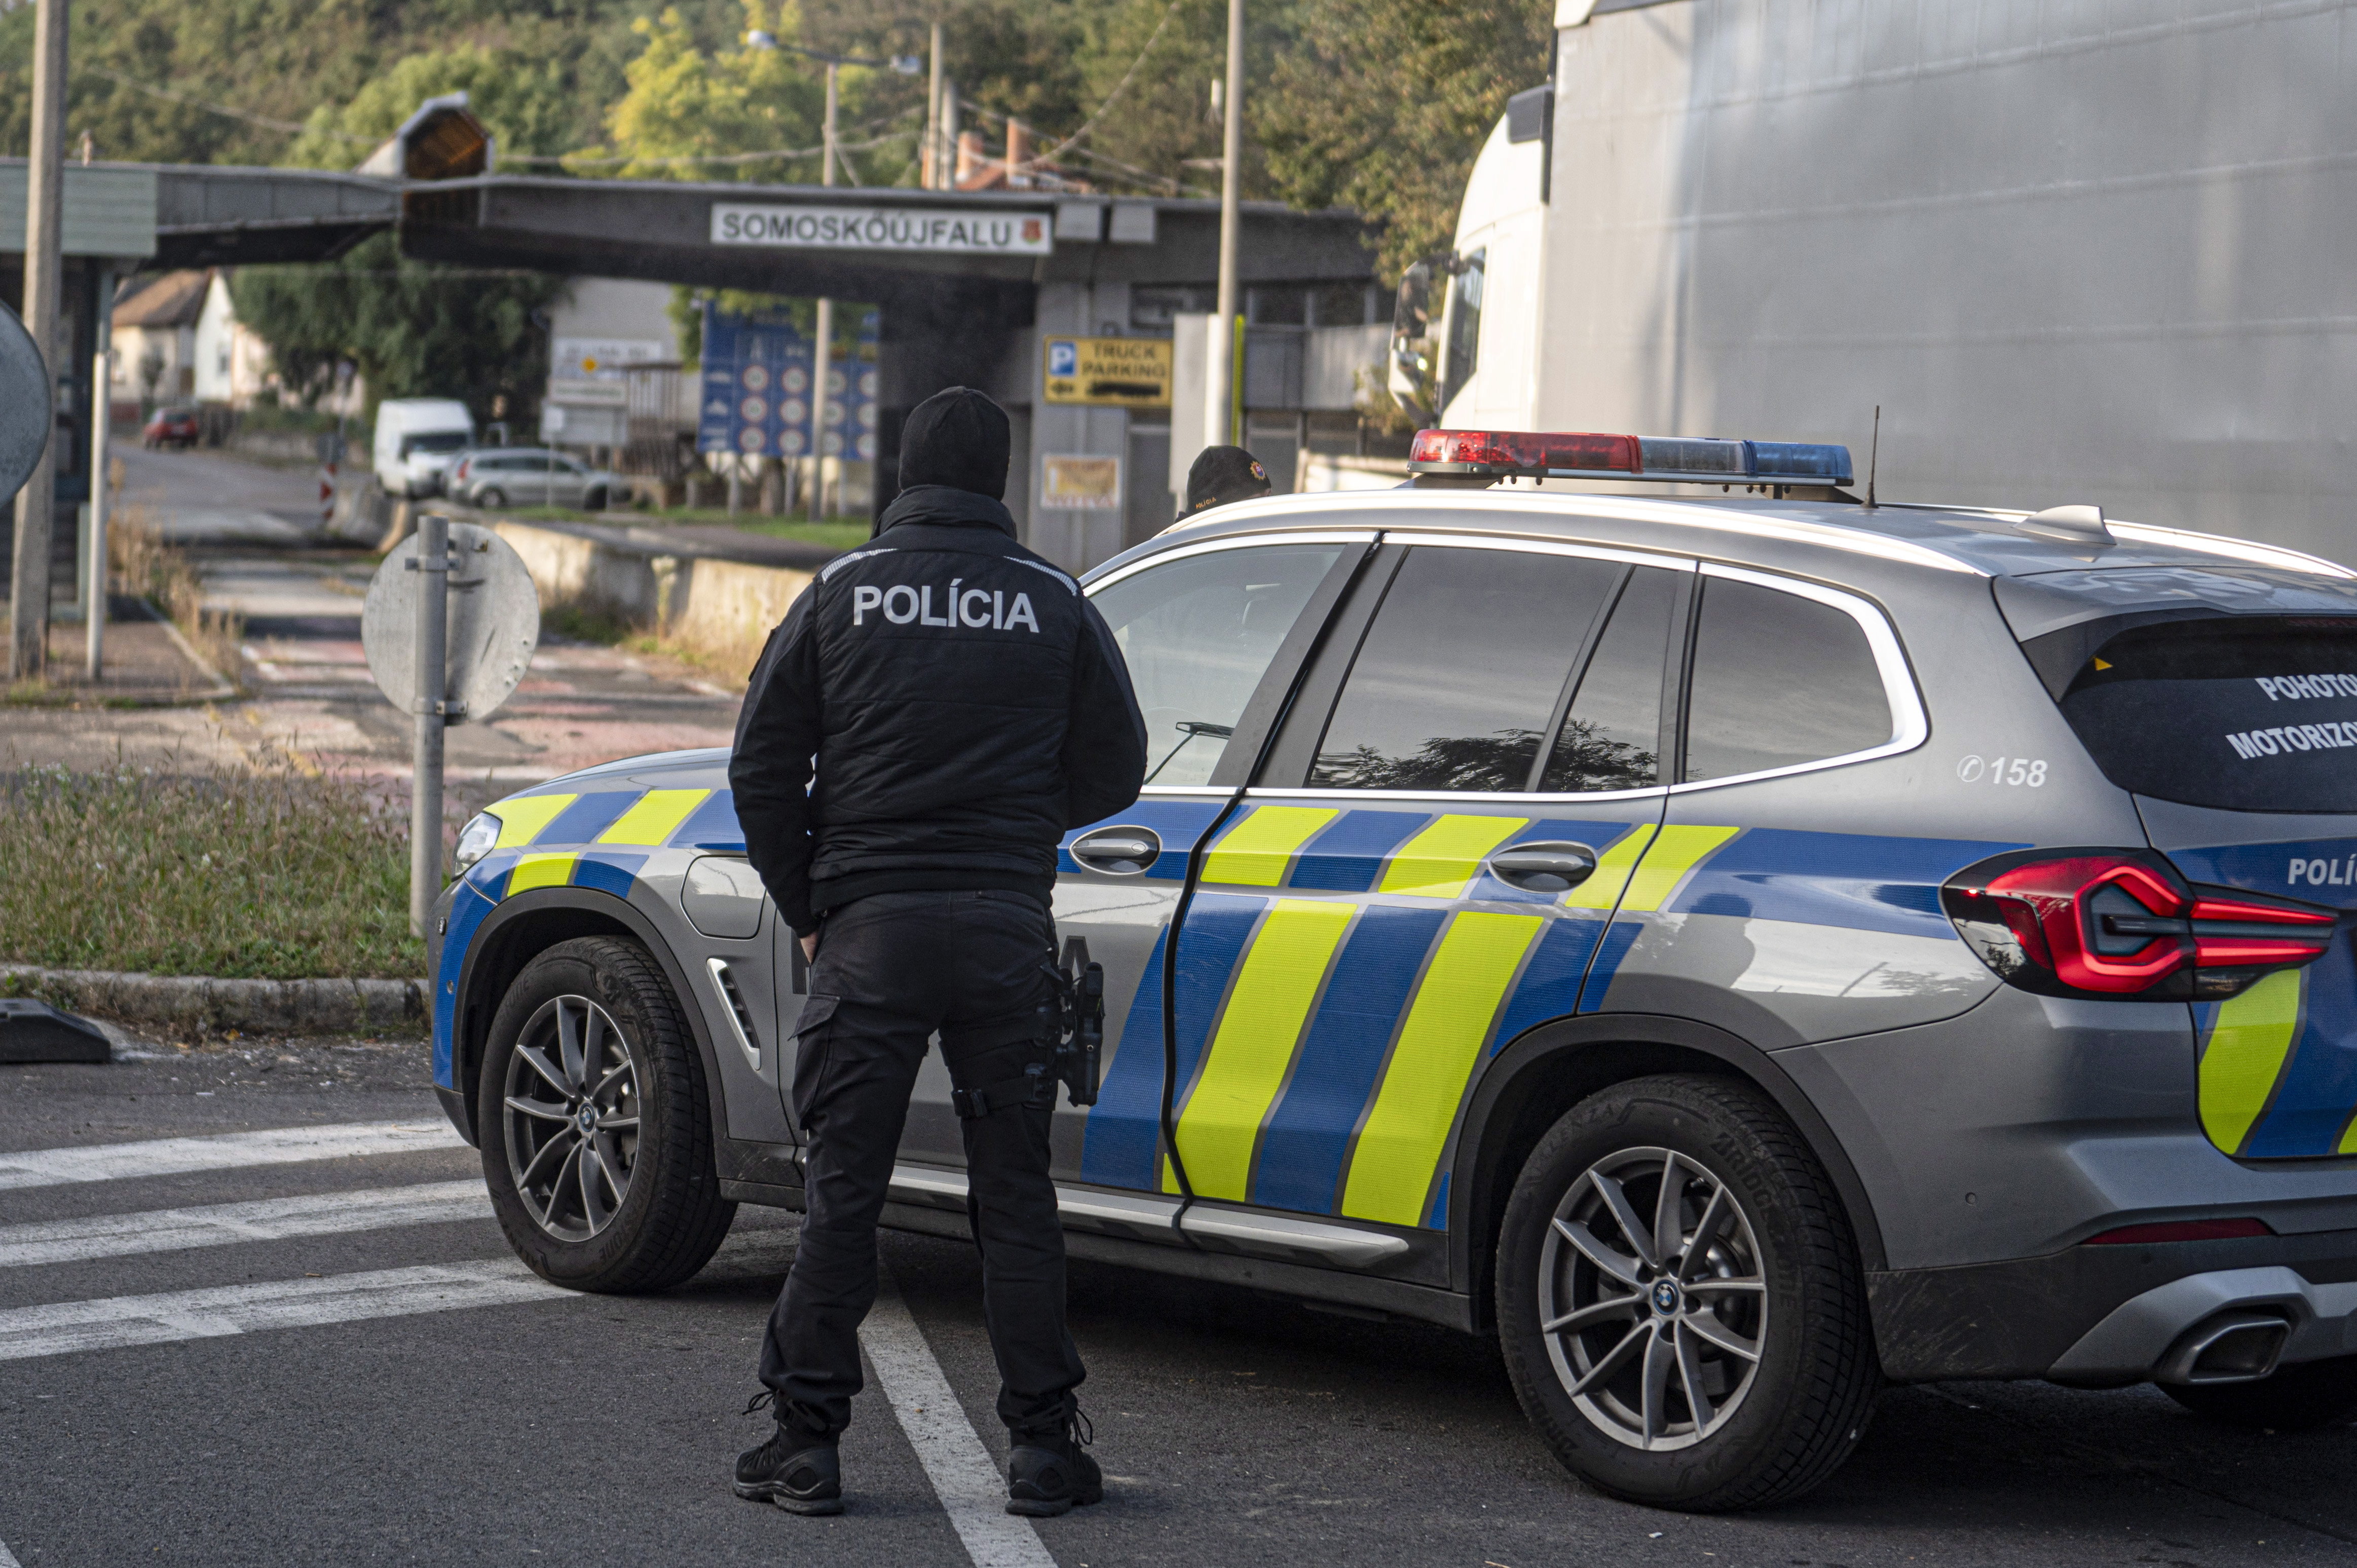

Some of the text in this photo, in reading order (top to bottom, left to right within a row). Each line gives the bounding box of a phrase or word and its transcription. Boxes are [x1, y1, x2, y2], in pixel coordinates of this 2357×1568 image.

[1094, 343, 1155, 359] TRUCK
[1082, 362, 1166, 377] PARKING
[1195, 496, 1217, 509] POLÍCIA
[853, 578, 1040, 633] POLÍCIA
[2255, 674, 2357, 701] POHOTO
[2226, 721, 2357, 759] MOTORIZO
[1990, 757, 2048, 787] 158
[2288, 853, 2357, 885] POLÍ
